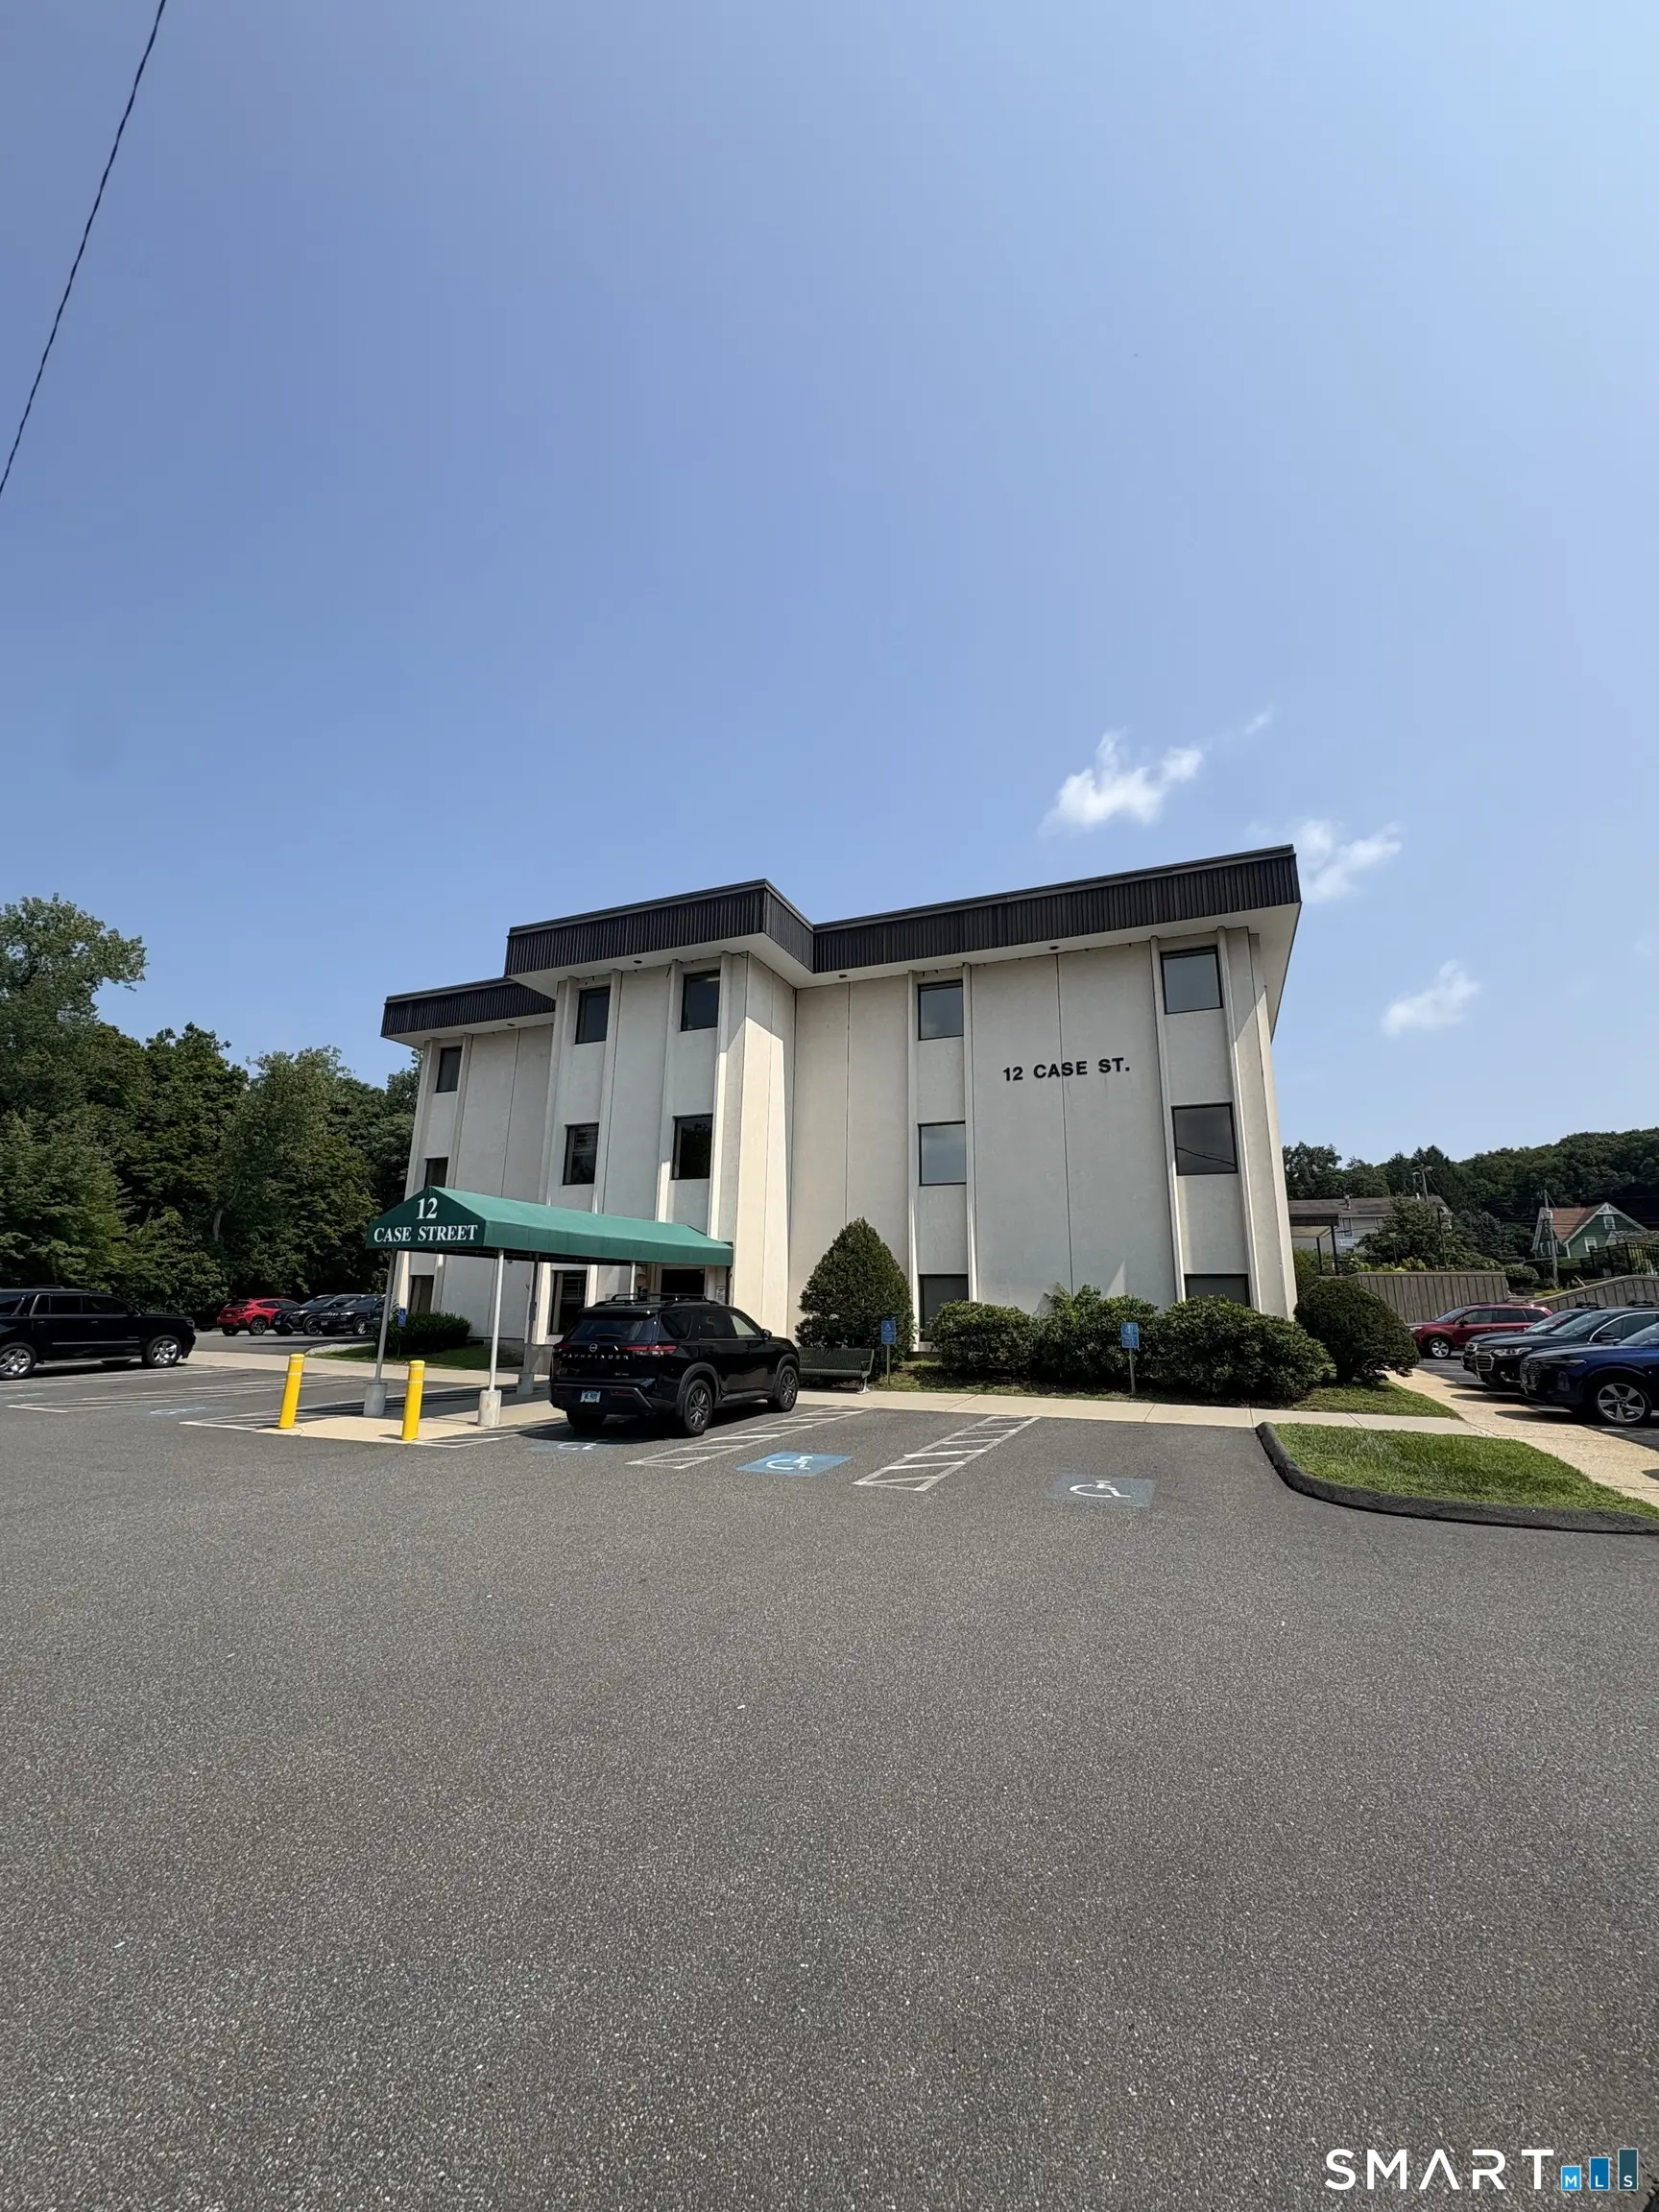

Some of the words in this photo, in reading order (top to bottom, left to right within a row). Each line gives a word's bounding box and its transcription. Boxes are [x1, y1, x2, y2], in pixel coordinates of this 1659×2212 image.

[1002, 1066, 1023, 1081] 12
[1033, 1061, 1088, 1079] CASE
[1098, 1057, 1130, 1073] ST.
[415, 1197, 439, 1219] 12
[373, 1226, 412, 1242] CASE
[418, 1224, 478, 1241] STREET
